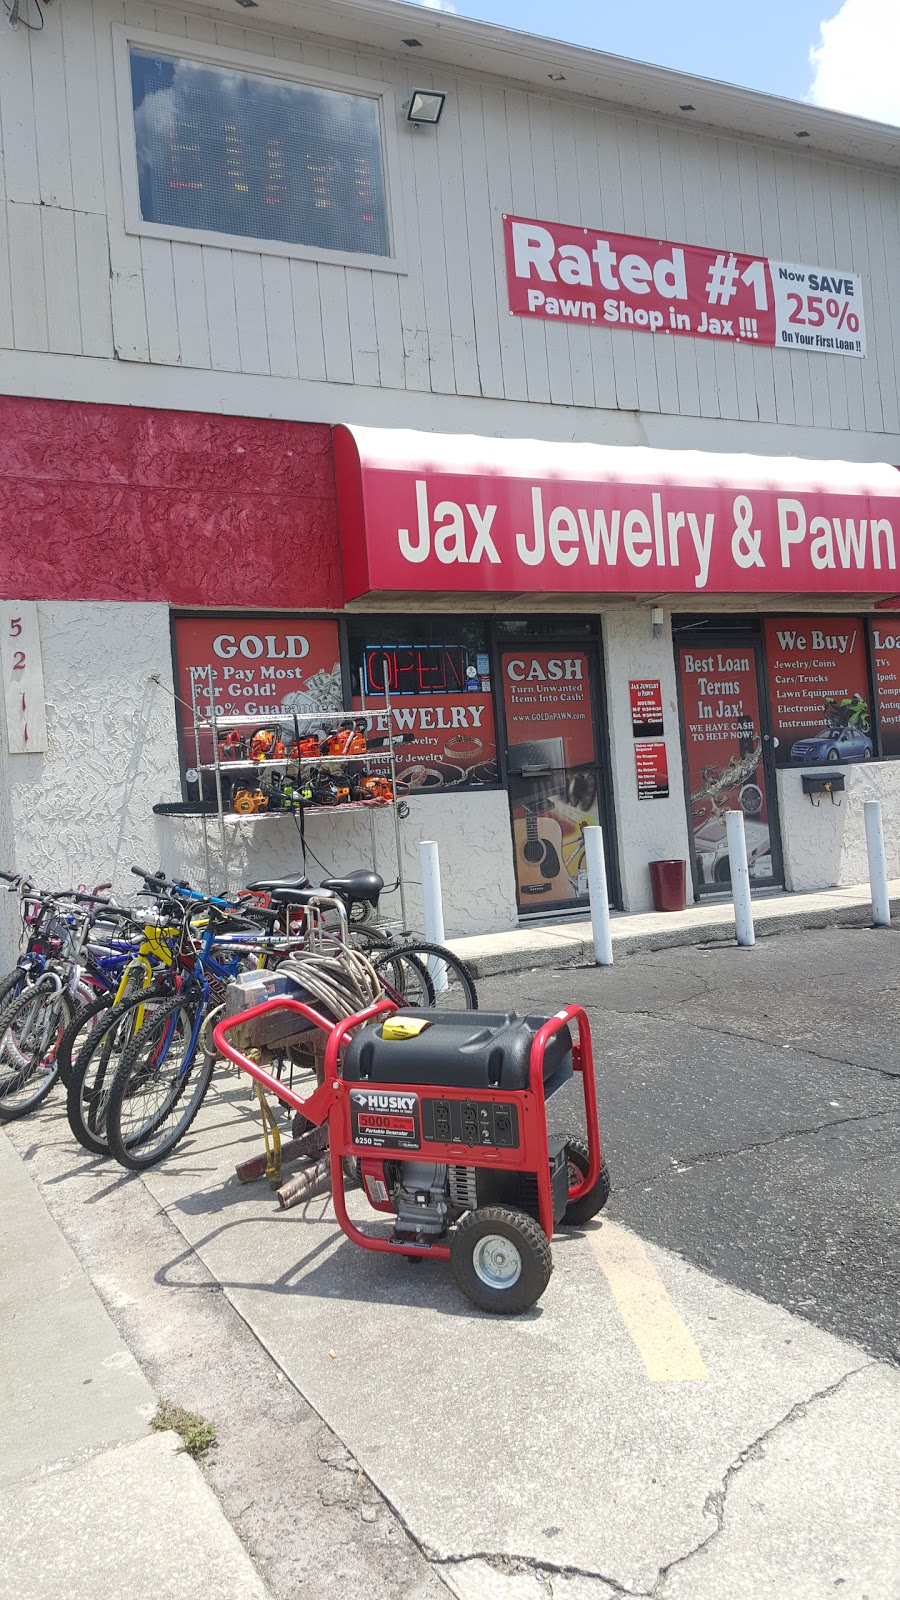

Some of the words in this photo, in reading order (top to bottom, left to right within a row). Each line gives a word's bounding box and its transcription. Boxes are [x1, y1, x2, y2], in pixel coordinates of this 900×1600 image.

[511, 222, 688, 300] Rated
[705, 254, 768, 311] #1
[778, 268, 805, 283] Now
[808, 276, 855, 296] SAVE
[527, 289, 597, 320] Pawn
[603, 299, 664, 332] Shop
[670, 306, 691, 331] in
[697, 312, 734, 337] Jax
[787, 293, 860, 333] 25%
[781, 330, 793, 343] On
[794, 332, 814, 346] Your
[815, 334, 834, 349] First
[835, 337, 855, 351] Loan
[398, 480, 502, 564] Jax
[515, 487, 715, 588] Jewelry
[731, 495, 766, 569] &
[776, 498, 896, 570] Pawn
[212, 634, 310, 659] GOLD
[776, 631, 807, 651] We
[811, 630, 857, 654] Buy/
[507, 659, 583, 680] CASH
[684, 654, 714, 673] Best
[717, 654, 750, 672] Loan
[774, 659, 836, 669] Jewelry/Coins
[876, 658, 890, 667] TVs
[189, 666, 217, 680] We
[222, 666, 255, 682] Pay
[260, 666, 303, 680] Most
[368, 651, 465, 690] OPEN
[698, 677, 740, 696] Terms
[775, 674, 829, 684] Cars/Trucks
[194, 683, 223, 697] For
[228, 683, 277, 697] Gold!
[511, 685, 534, 693] Turn
[536, 684, 582, 692] Unwanted
[776, 690, 800, 699] Lawn
[802, 688, 849, 698] Equipment
[511, 695, 537, 703] Items
[539, 694, 558, 702] Into
[560, 693, 584, 701] Cash!
[244, 702, 337, 716] Guarantee
[698, 701, 713, 719] In
[715, 700, 744, 718] Jax!
[777, 703, 826, 713] Electronics
[359, 706, 486, 732] JEWELRY
[778, 718, 832, 728] Instruments
[689, 724, 703, 732] WE
[705, 723, 729, 731] HAVE
[731, 722, 754, 730] CASH
[692, 733, 704, 741] TO
[706, 732, 729, 740] HELP
[730, 731, 753, 739] NOW!
[395, 754, 404, 763] &
[405, 752, 444, 763] Jewelry
[368, 1095, 416, 1110] HUSKY
[361, 1115, 390, 1127] 5000
[355, 1137, 372, 1145] 6250
